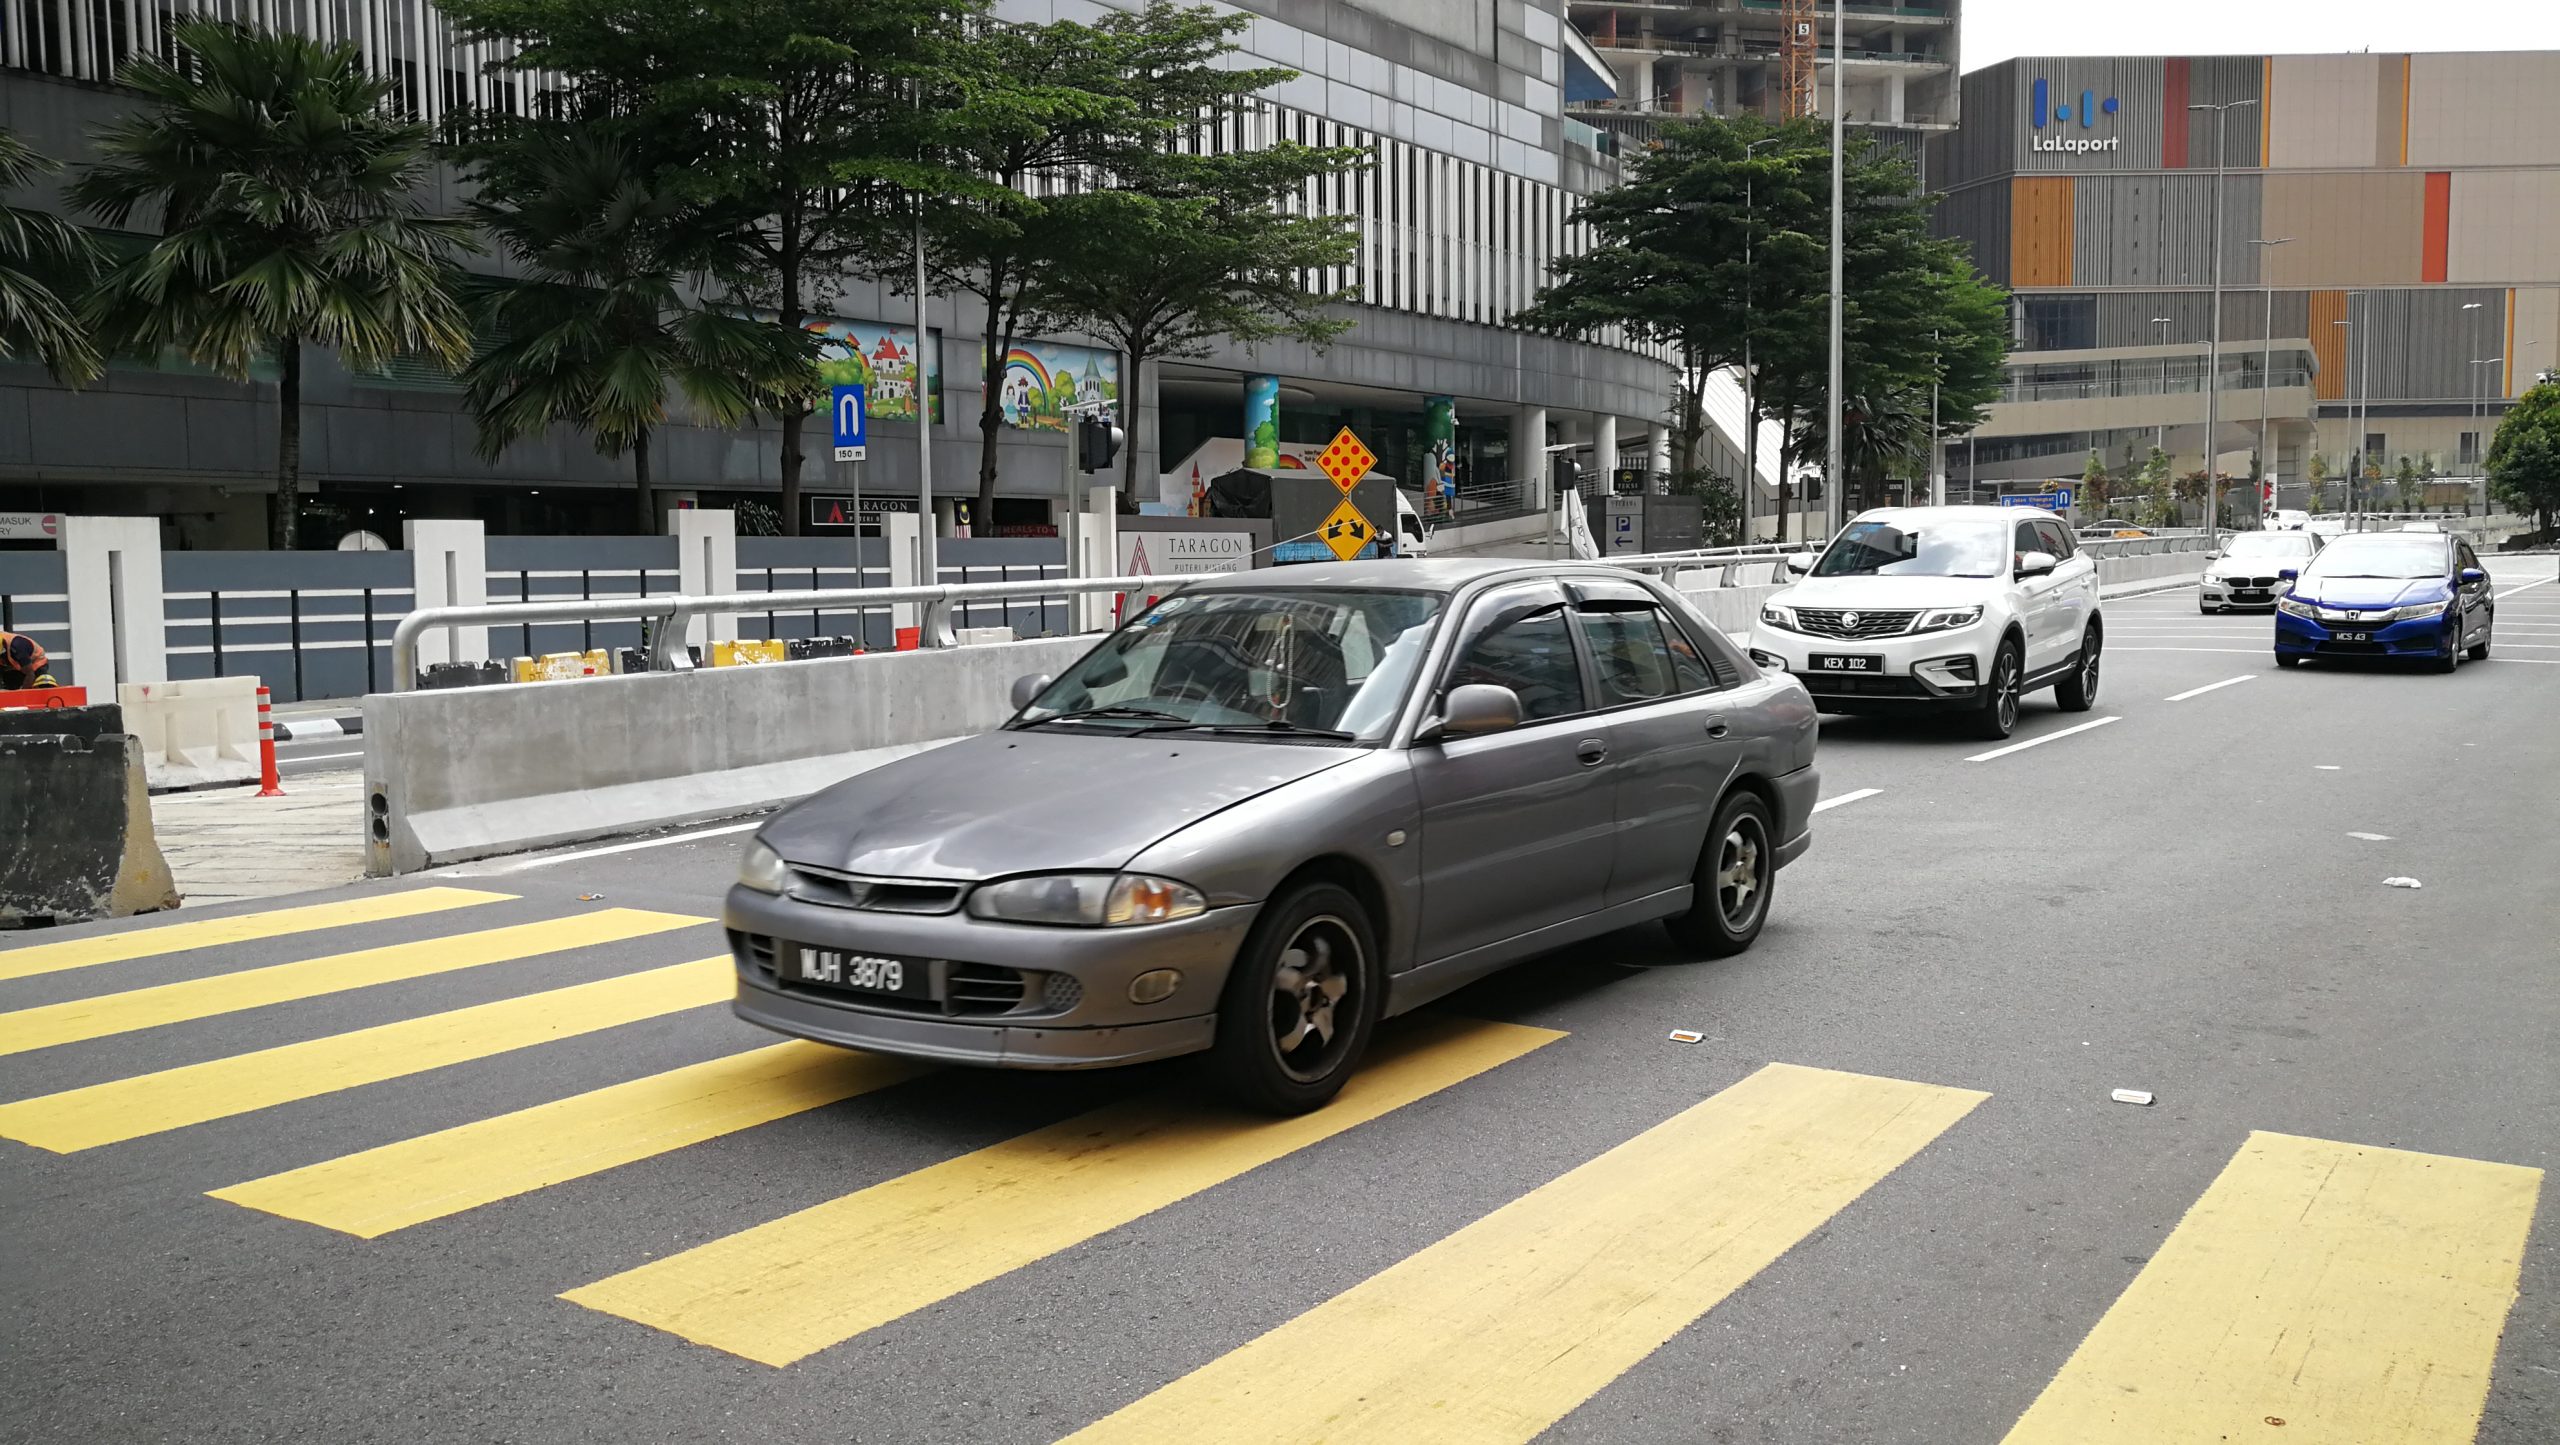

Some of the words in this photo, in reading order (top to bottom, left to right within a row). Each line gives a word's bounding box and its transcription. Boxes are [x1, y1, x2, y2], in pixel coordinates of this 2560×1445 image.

[1801, 25, 1807, 33] 5
[2033, 135, 2118, 155] LaLaport
[839, 450, 852, 458] 150
[846, 501, 908, 511] TRAGON
[1169, 538, 1242, 553] TARAGON
[1174, 564, 1201, 572] PUTERI
[1824, 657, 1844, 669] KEX
[1848, 658, 1867, 669] 102
[800, 948, 841, 983] WJH
[849, 956, 903, 990] 3879
